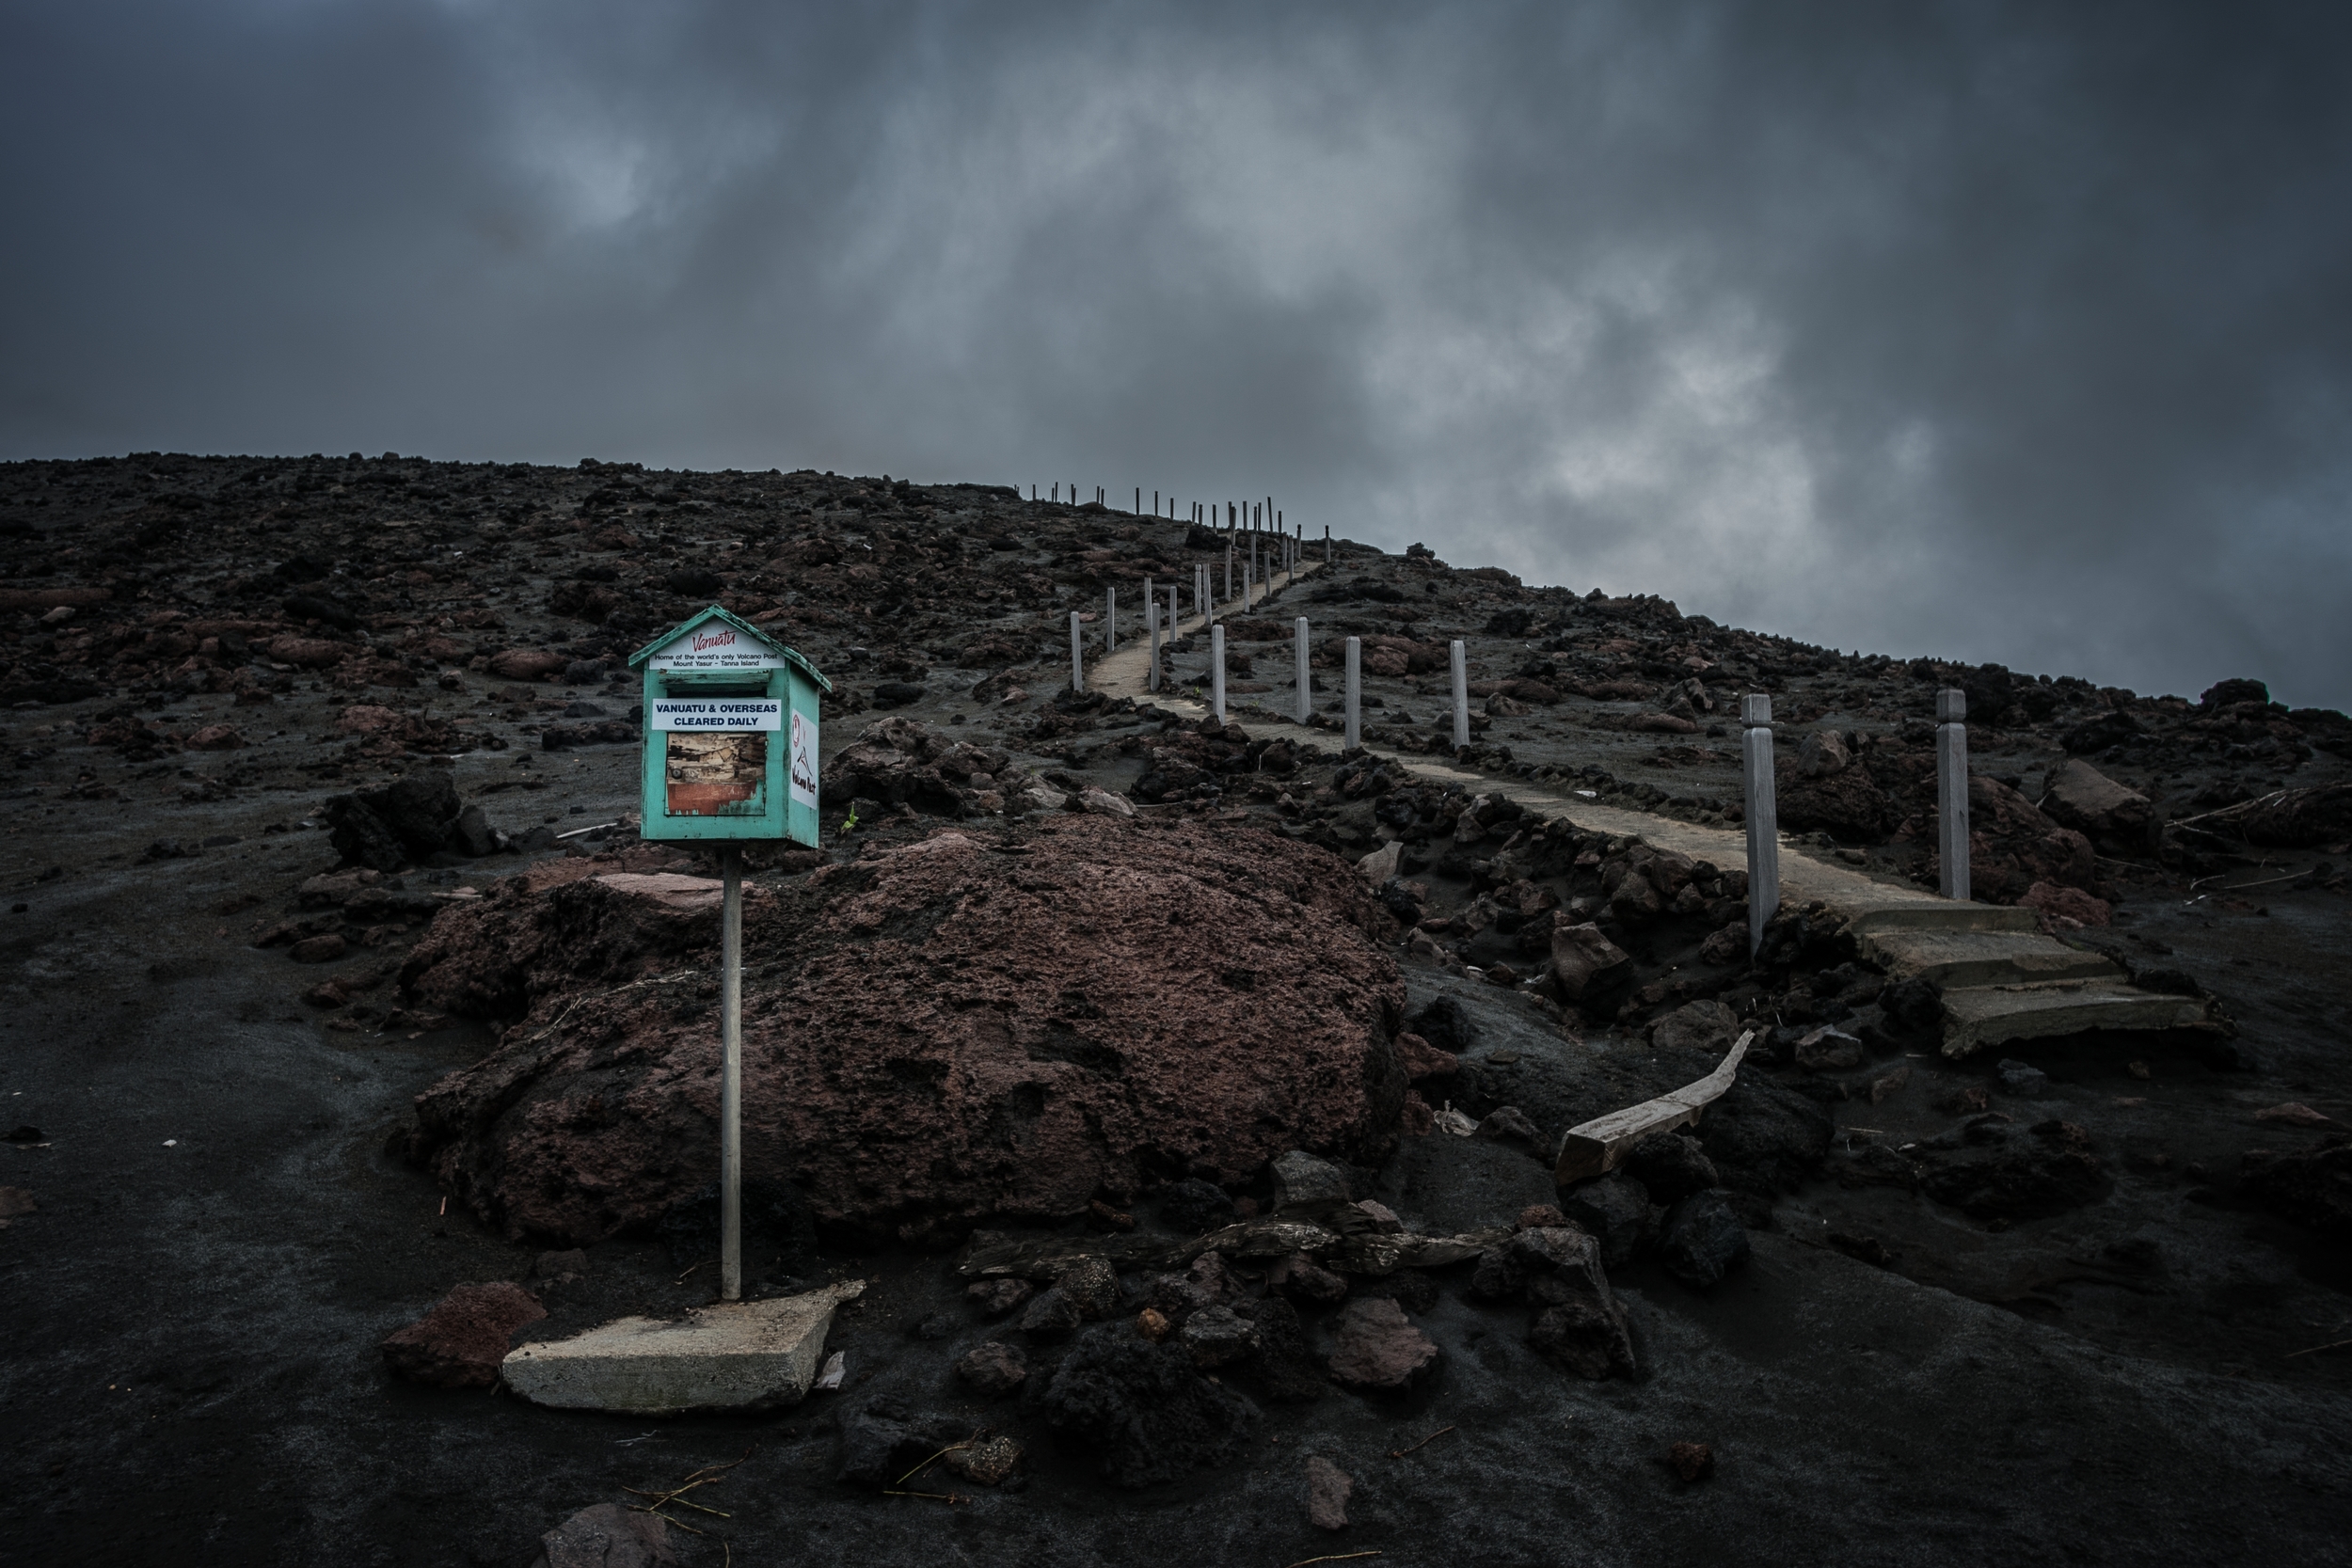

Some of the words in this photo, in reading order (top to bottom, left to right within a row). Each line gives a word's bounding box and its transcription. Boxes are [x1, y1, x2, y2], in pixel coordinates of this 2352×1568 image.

[692, 630, 737, 652] Vanuatu
[656, 704, 706, 713] VANUATU
[708, 704, 716, 713] &
[720, 704, 778, 713] OVERSEAS
[674, 717, 724, 726] CLEARED
[727, 717, 759, 726] DAILY
